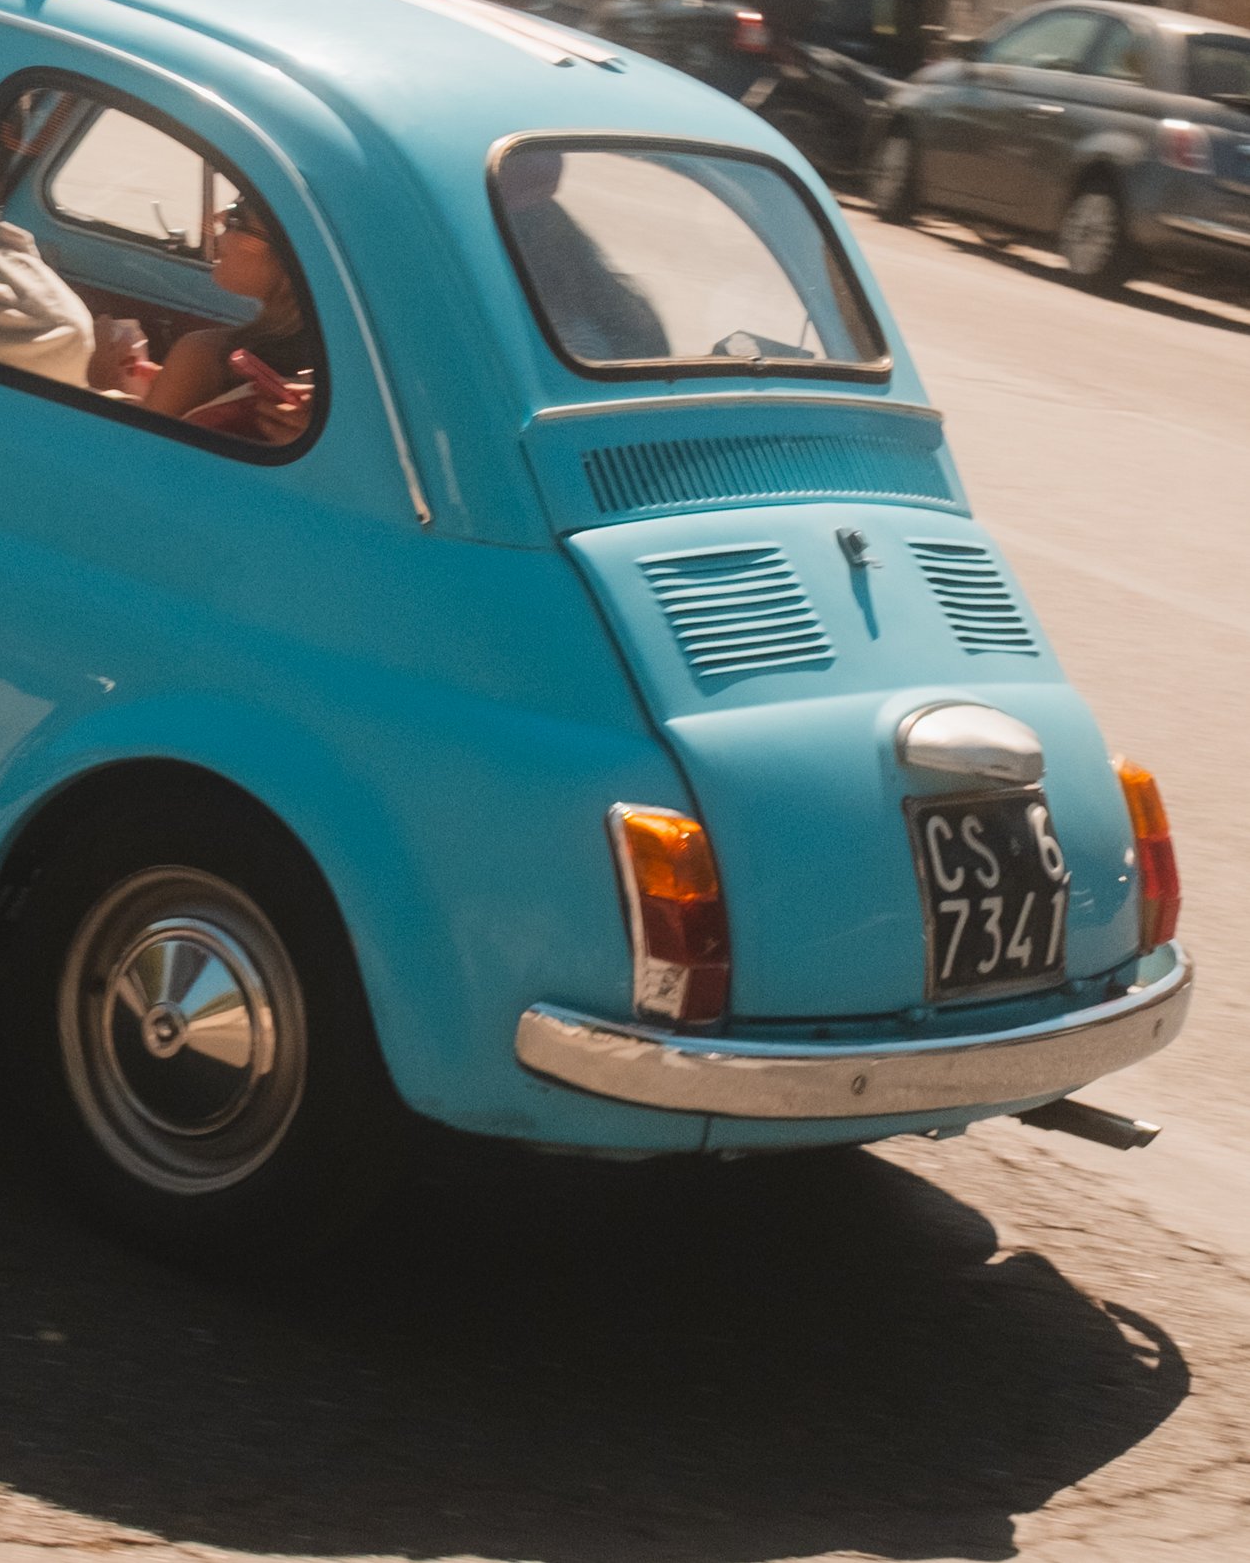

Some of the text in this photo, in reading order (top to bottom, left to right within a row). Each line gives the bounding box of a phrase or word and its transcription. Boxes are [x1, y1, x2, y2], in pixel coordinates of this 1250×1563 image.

[925, 802, 1066, 893] CS 6
[939, 890, 1066, 980] 7341
